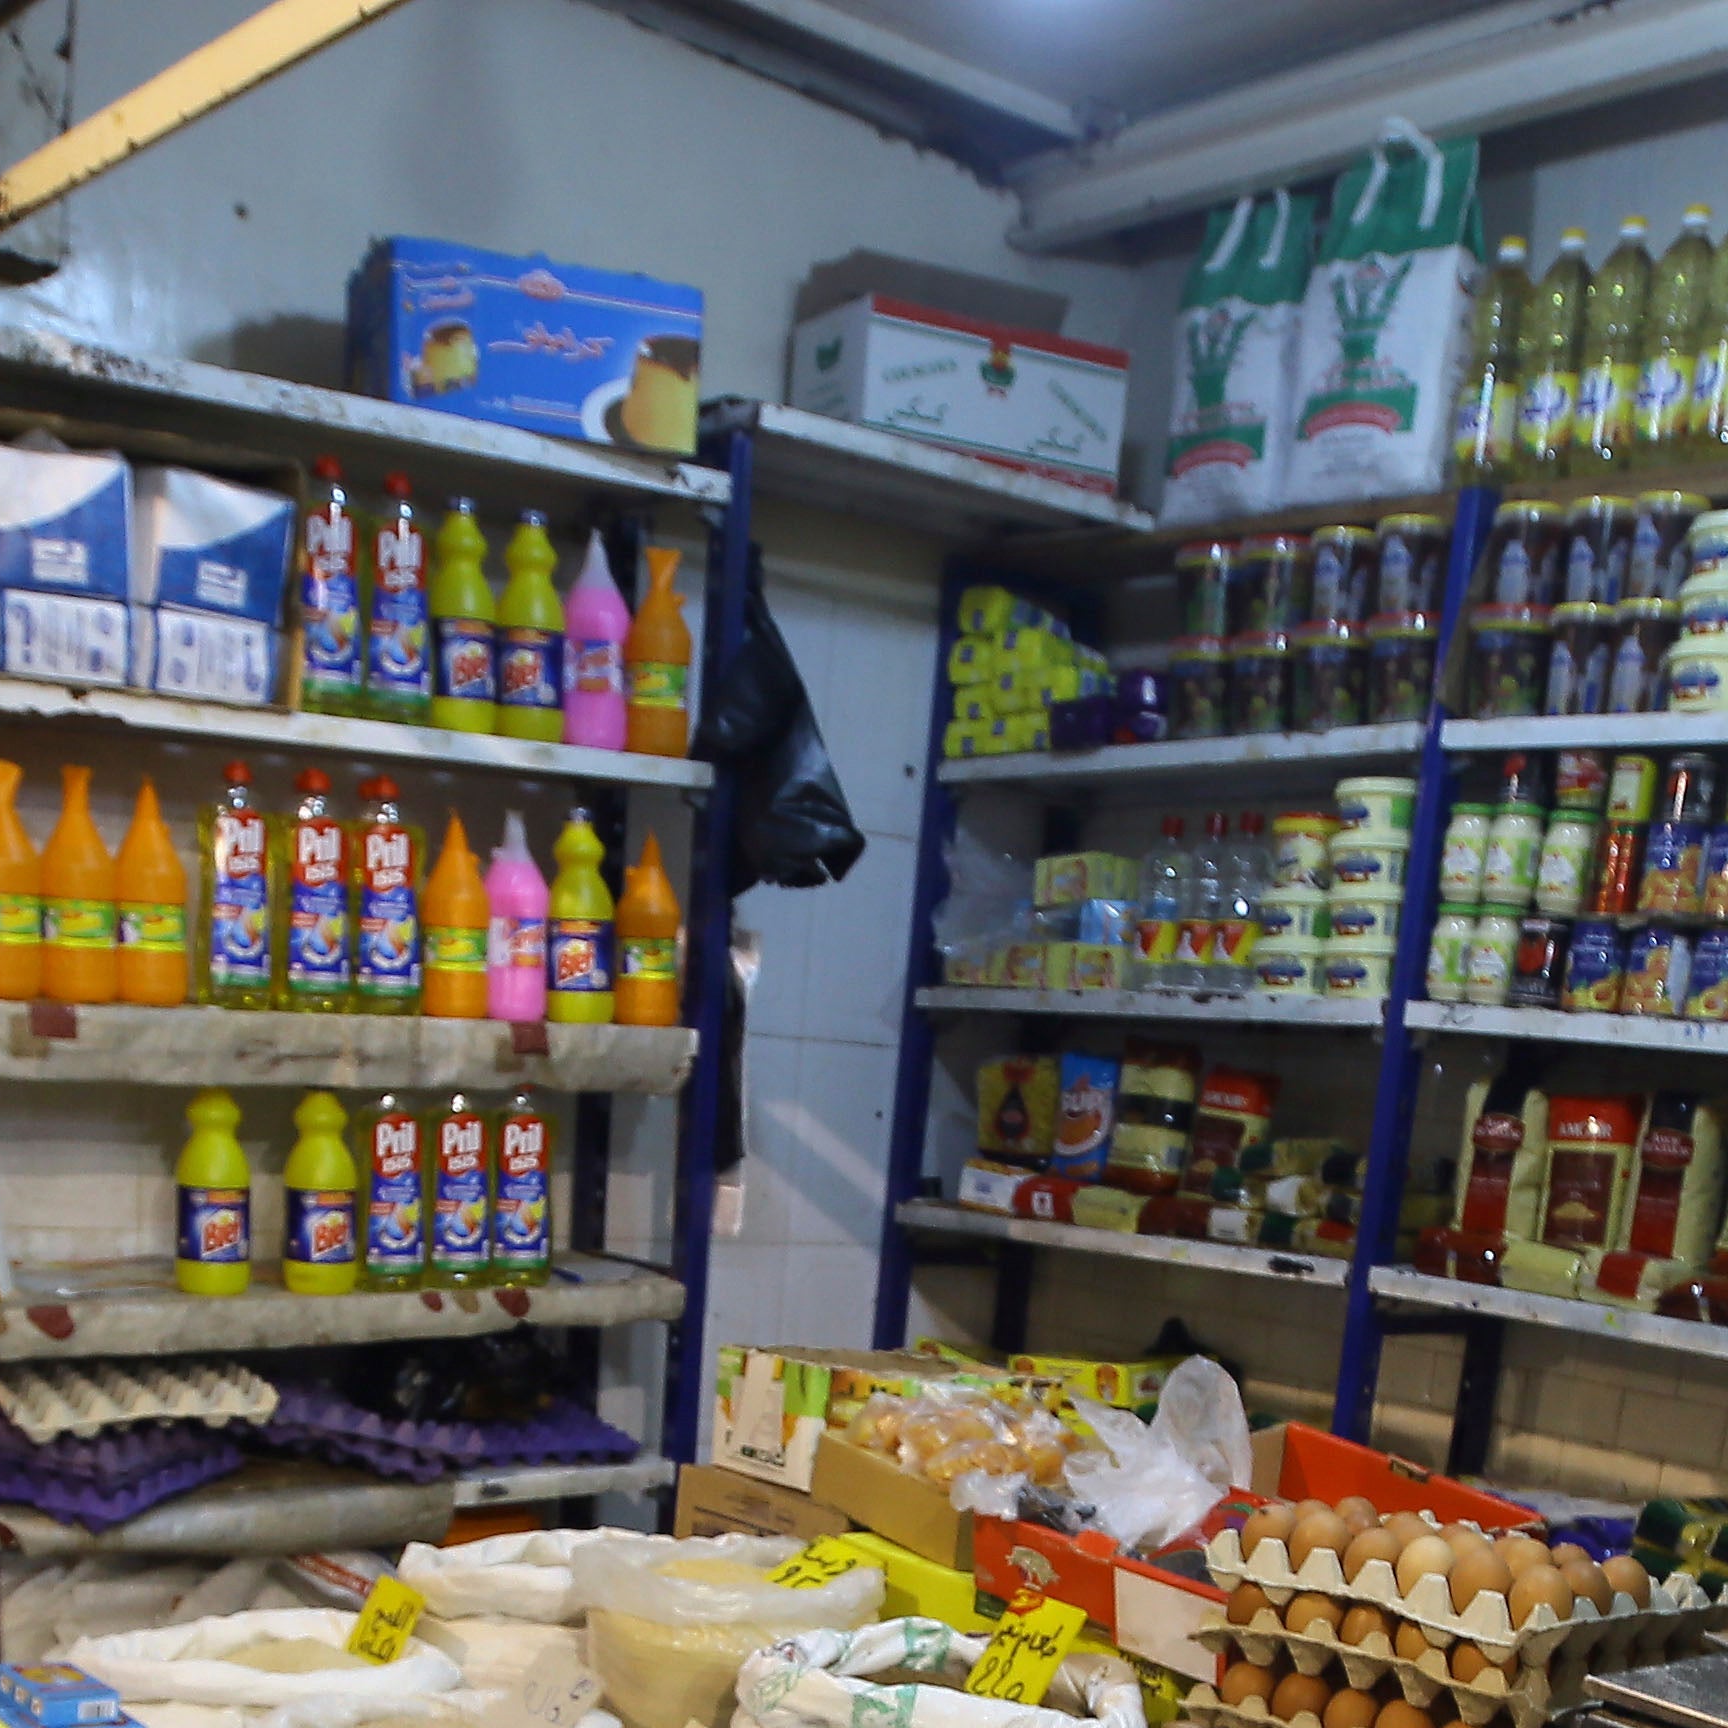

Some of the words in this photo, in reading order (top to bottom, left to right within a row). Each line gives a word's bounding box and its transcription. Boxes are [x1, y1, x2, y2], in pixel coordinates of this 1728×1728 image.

[297, 826, 341, 863] Pril
[366, 833, 411, 869] Pril
[375, 1120, 418, 1155] Pril
[441, 1120, 482, 1154] Pril
[503, 1120, 544, 1154] Pril
